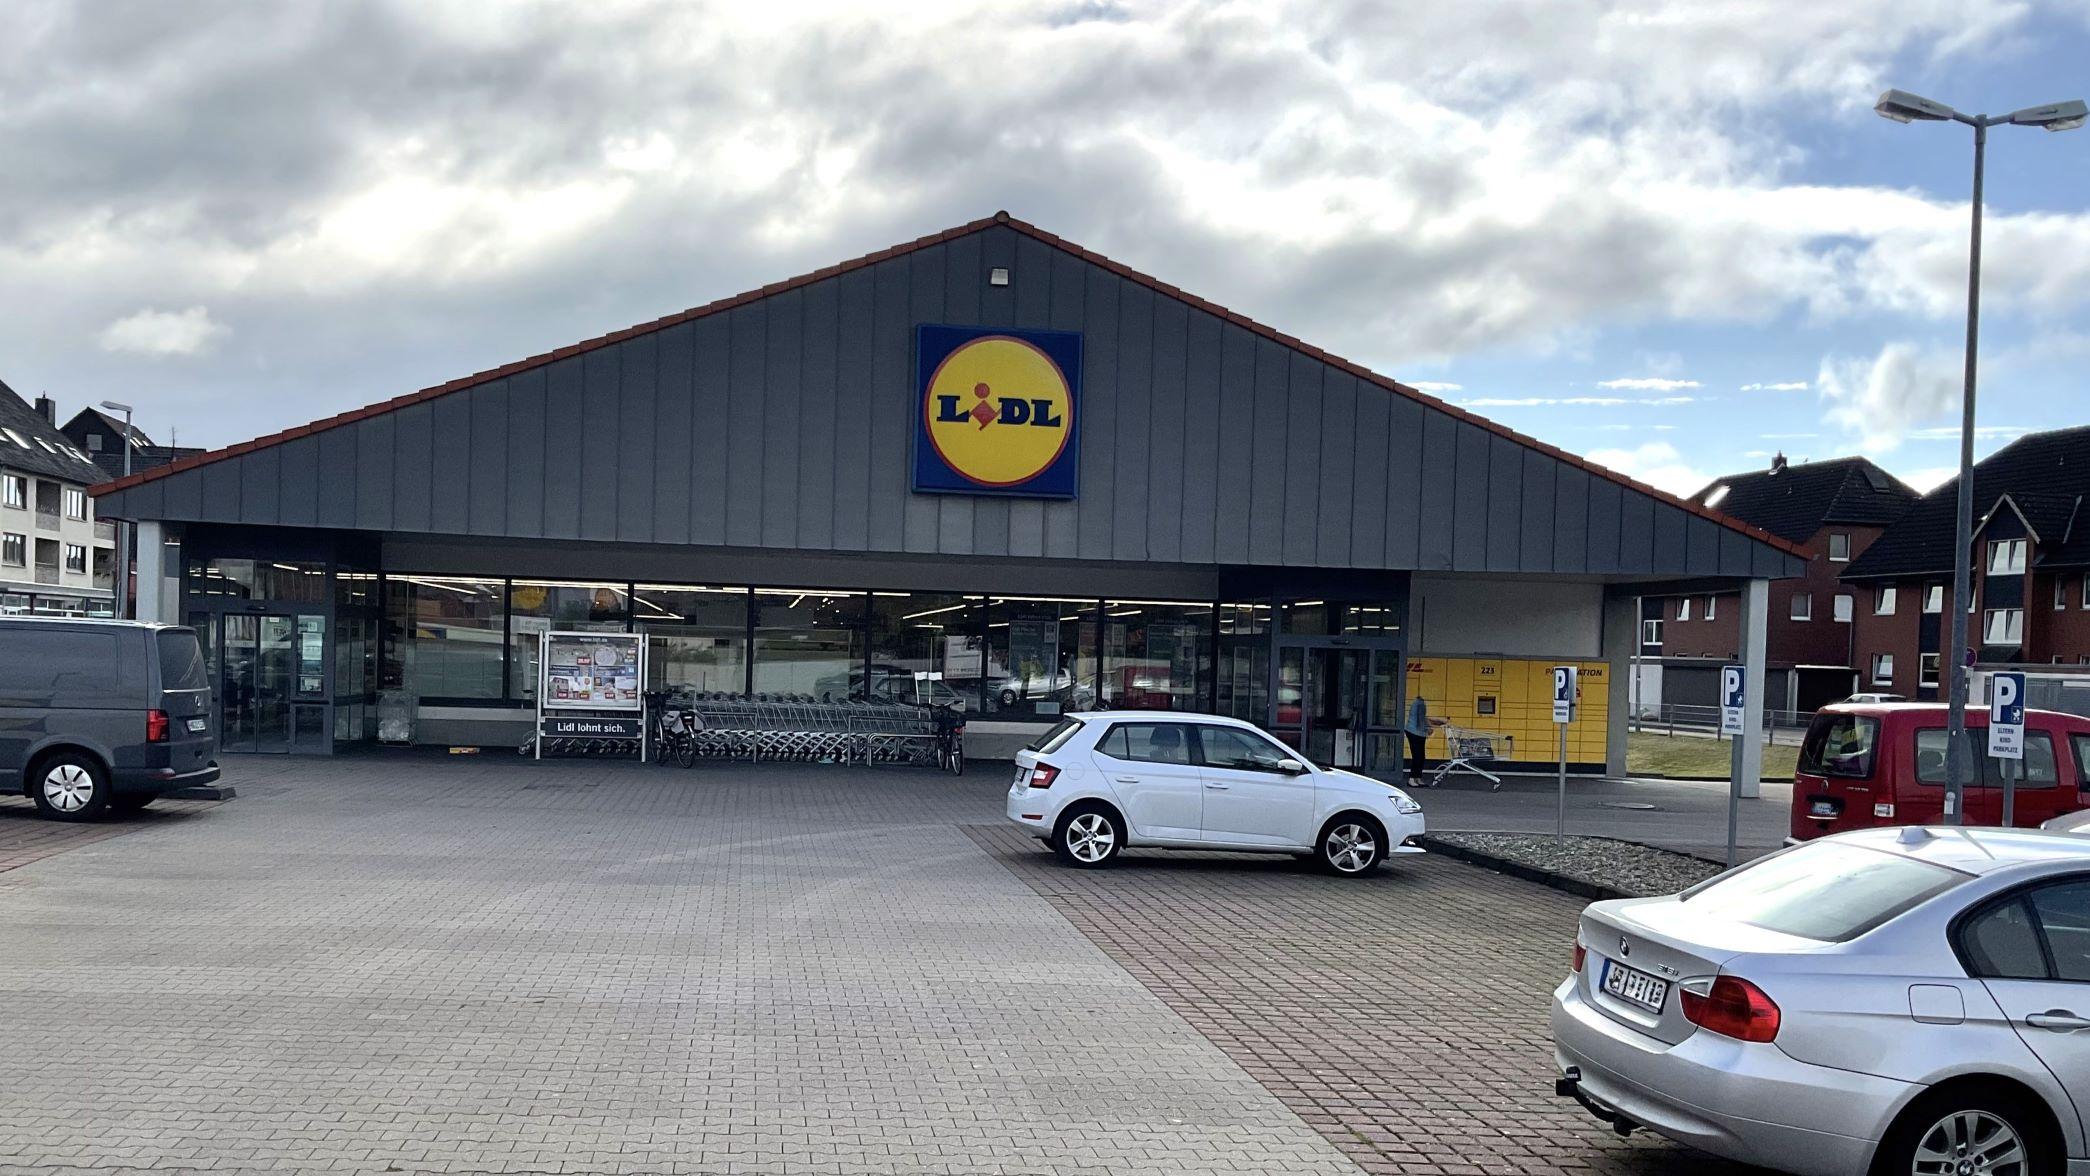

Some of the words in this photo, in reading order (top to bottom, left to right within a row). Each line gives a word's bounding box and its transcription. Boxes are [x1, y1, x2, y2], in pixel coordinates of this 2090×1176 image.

[1555, 669, 1566, 699] P
[1725, 669, 1740, 705] P
[1993, 676, 2017, 721] P
[557, 722, 575, 732] Lidl
[577, 722, 602, 732] lohnt
[603, 723, 626, 733] sich.
